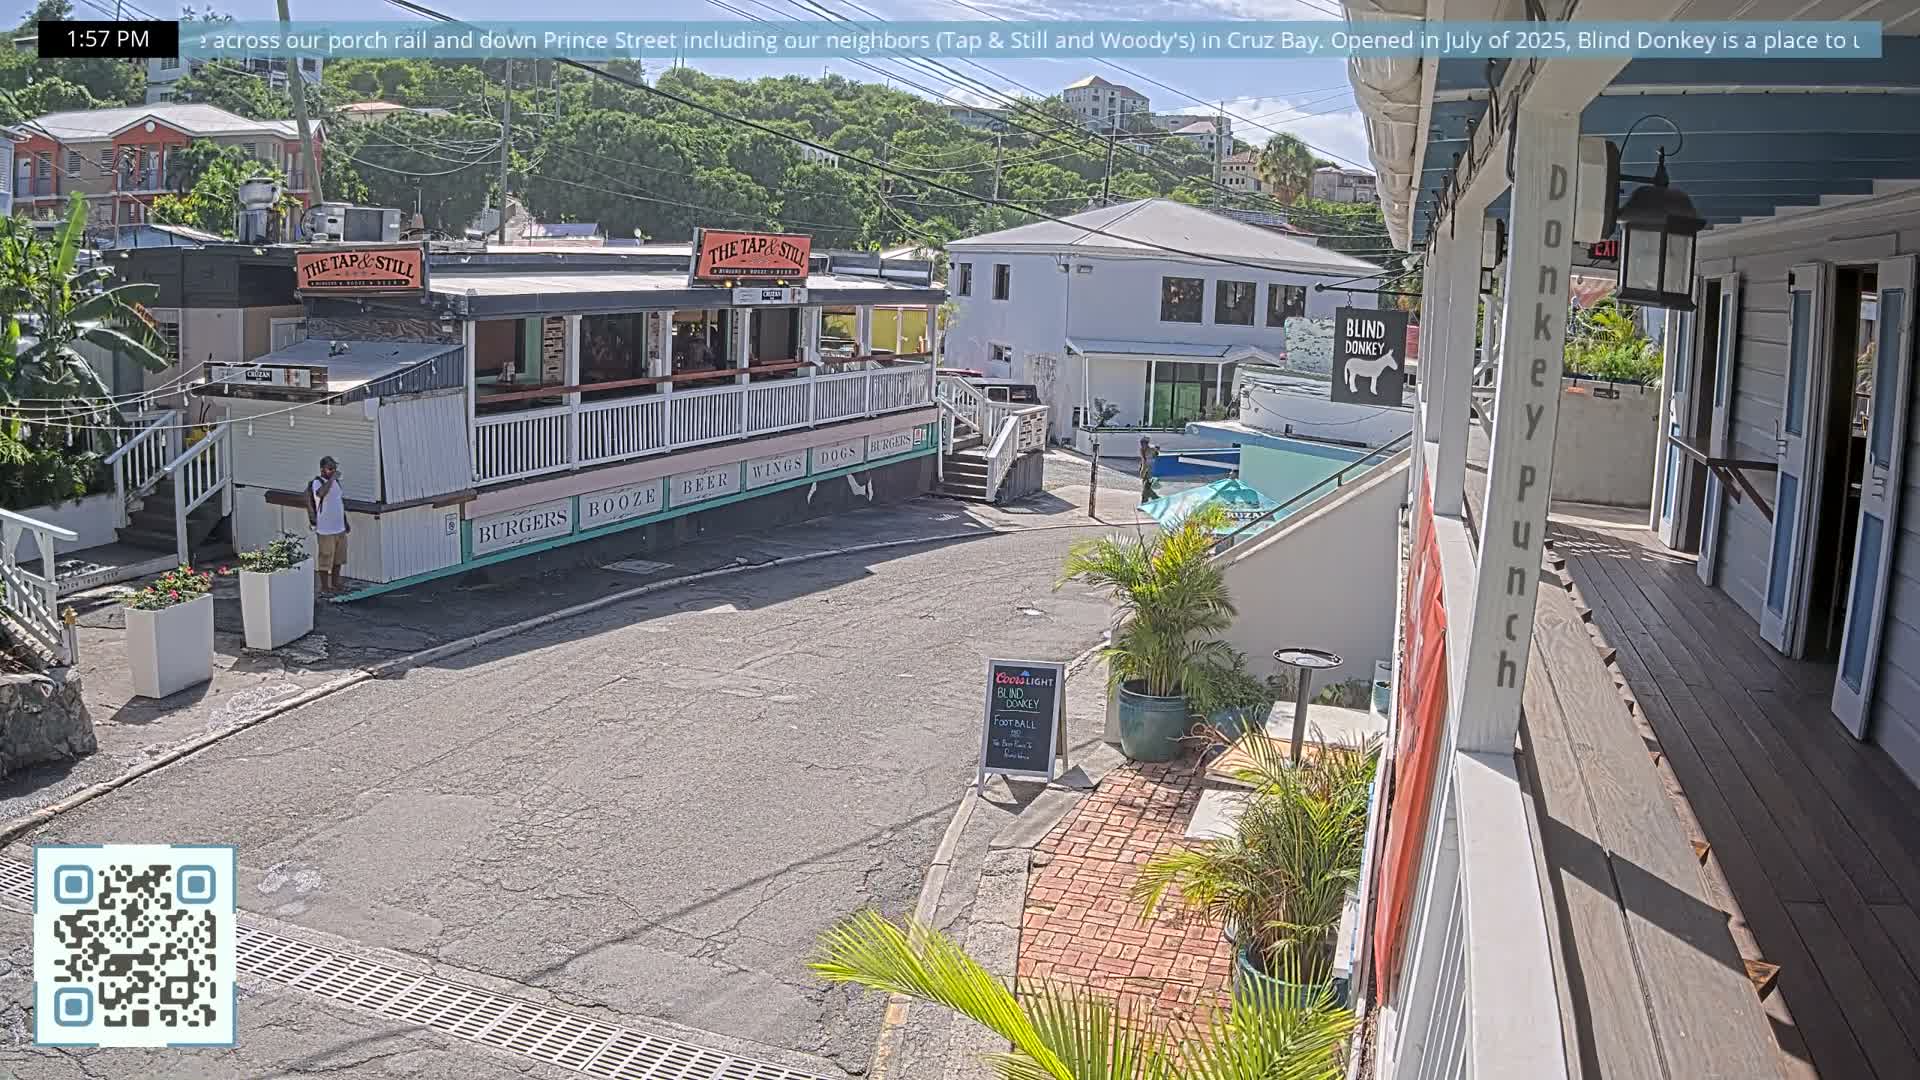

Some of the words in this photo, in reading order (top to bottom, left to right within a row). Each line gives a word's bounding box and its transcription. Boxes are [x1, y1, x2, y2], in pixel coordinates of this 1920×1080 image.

[709, 240, 738, 265] THE
[740, 238, 767, 255] TAP
[764, 238, 780, 257] &
[779, 241, 805, 268] STILL
[1595, 240, 1616, 257] EXI
[303, 259, 330, 279] THE
[330, 254, 359, 270] TAP
[357, 252, 376, 270] &
[375, 255, 415, 279] STILL
[1525, 164, 1568, 441] Donkey
[1346, 318, 1385, 339] BLIND
[1345, 339, 1385, 356] DONKEY
[870, 434, 912, 453] BURGERS
[821, 447, 856, 465] DOGS
[752, 457, 802, 480] WINGS
[683, 472, 729, 496] BEER
[588, 488, 656, 518] BOOZE
[479, 509, 568, 544] BURGERS
[996, 672, 1025, 685] Coors
[1026, 677, 1055, 687] LIGHT
[997, 686, 1024, 699] BLIND
[1006, 698, 1041, 710] DONKEY
